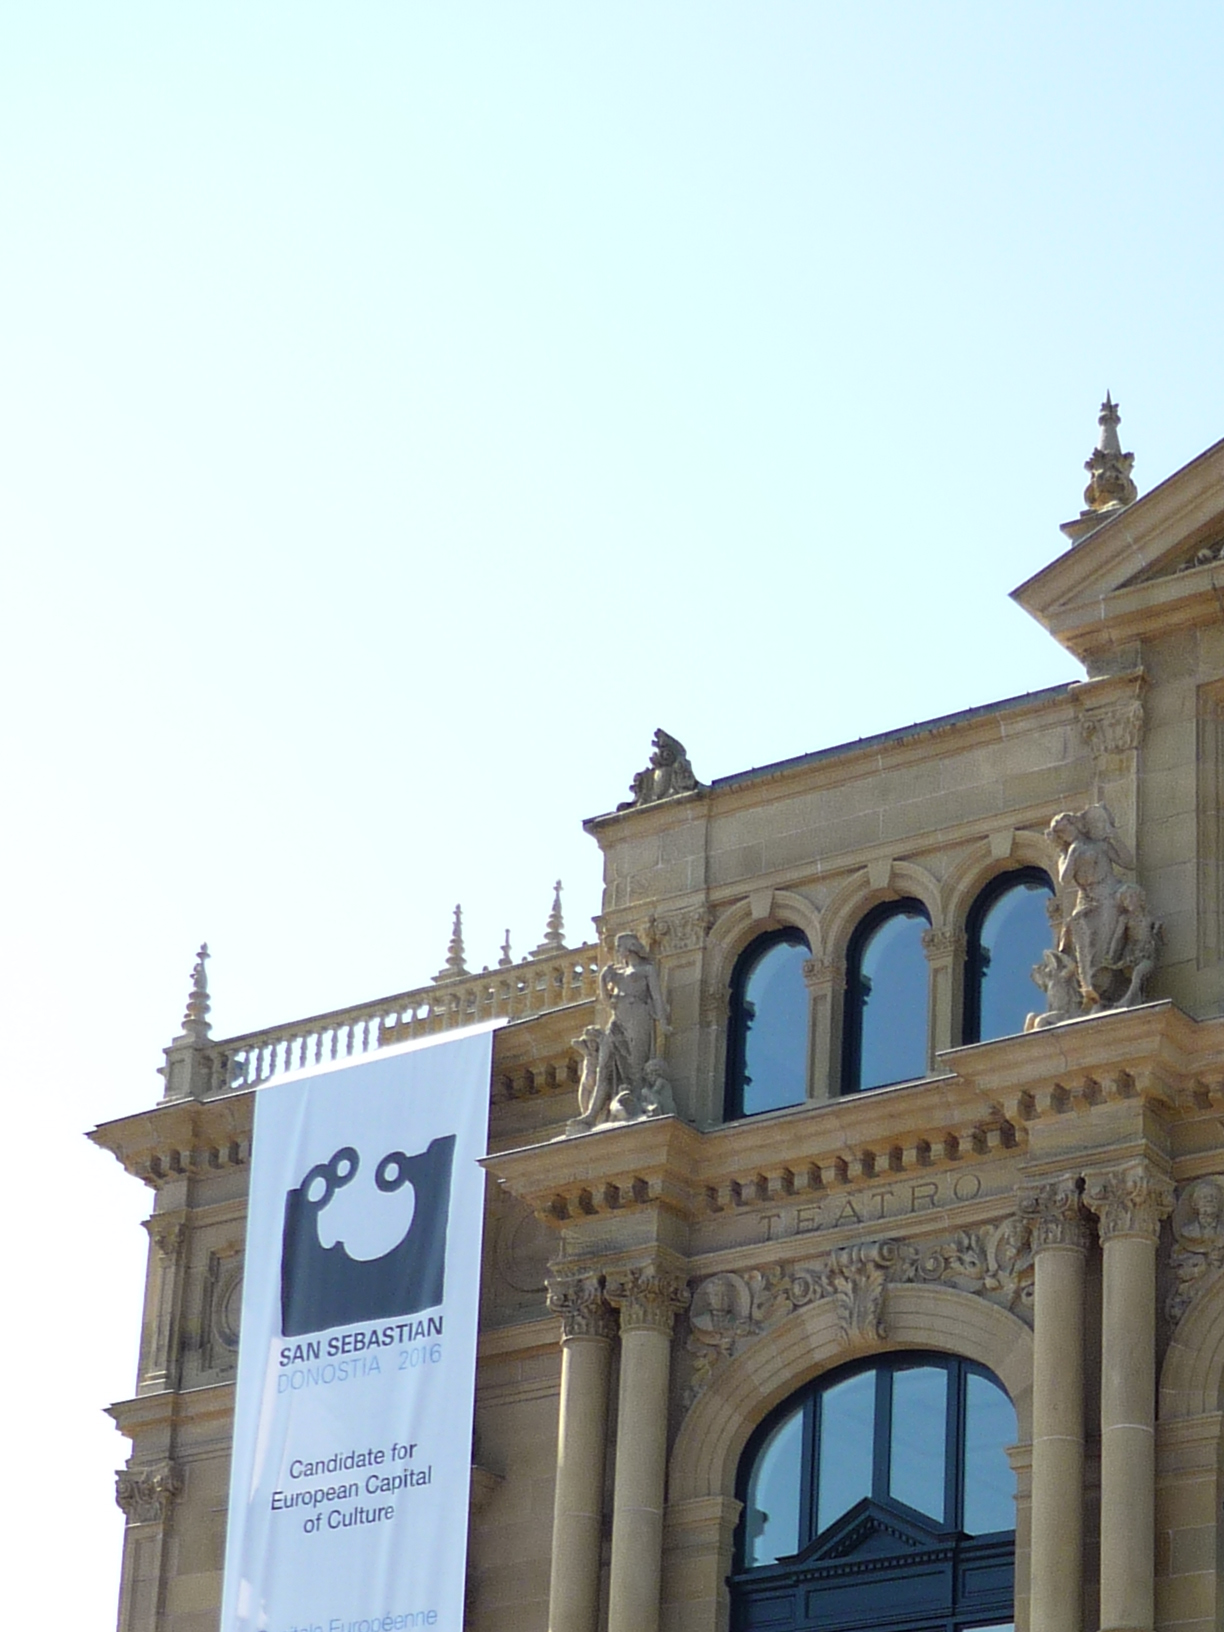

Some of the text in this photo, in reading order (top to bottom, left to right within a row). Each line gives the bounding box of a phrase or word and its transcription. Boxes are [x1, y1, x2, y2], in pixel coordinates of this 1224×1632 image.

[757, 1173, 982, 1242] TEATRO
[278, 1315, 443, 1367] SAN SEBASTIAN
[276, 1343, 442, 1394] DONOSTIA 2016
[289, 1442, 418, 1479] Candidate for
[271, 1465, 432, 1511] European Capital
[302, 1504, 395, 1534] of Culture
